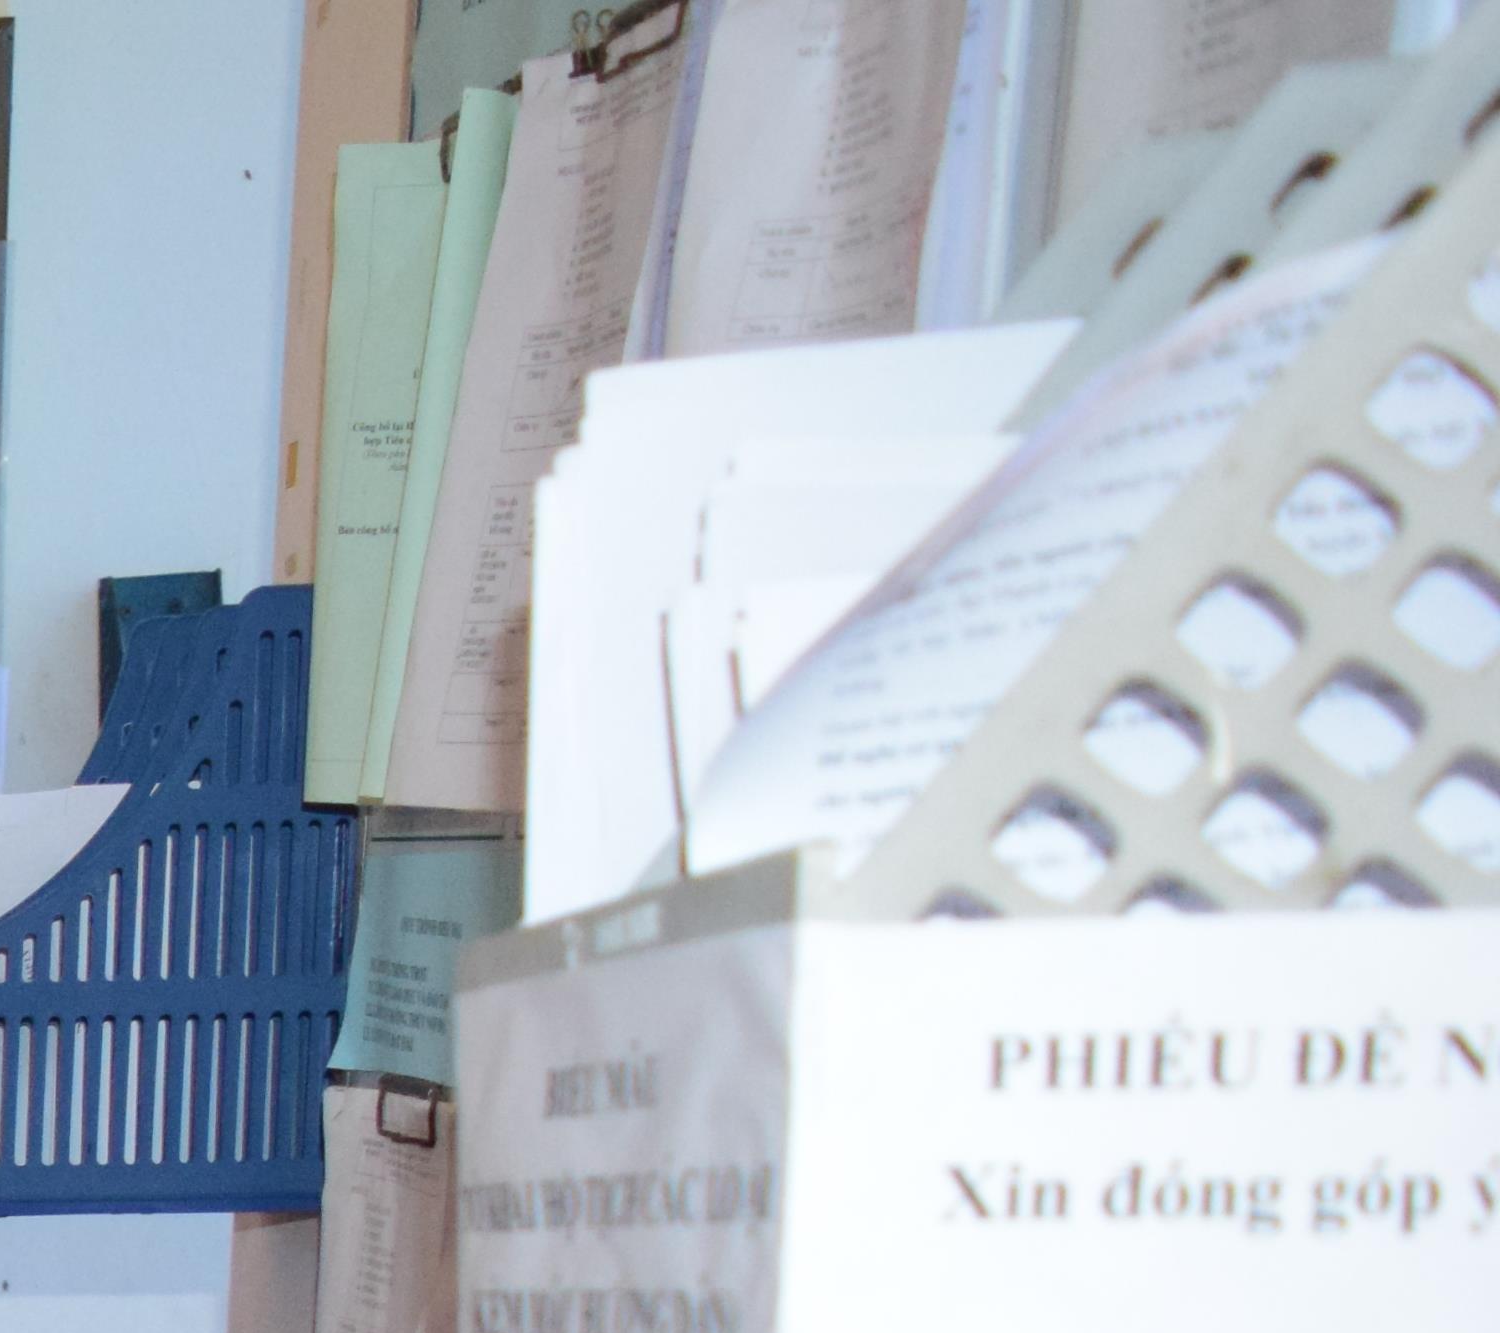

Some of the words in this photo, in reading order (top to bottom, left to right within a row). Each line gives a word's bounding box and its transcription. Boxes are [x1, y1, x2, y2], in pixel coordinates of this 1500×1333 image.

[986, 1012, 1262, 1092] PHIẾU
[1293, 1010, 1406, 1088] ĐỀ
[941, 1162, 1070, 1224] Xin
[1100, 1157, 1285, 1233] đóng
[1310, 1157, 1443, 1233] góp
